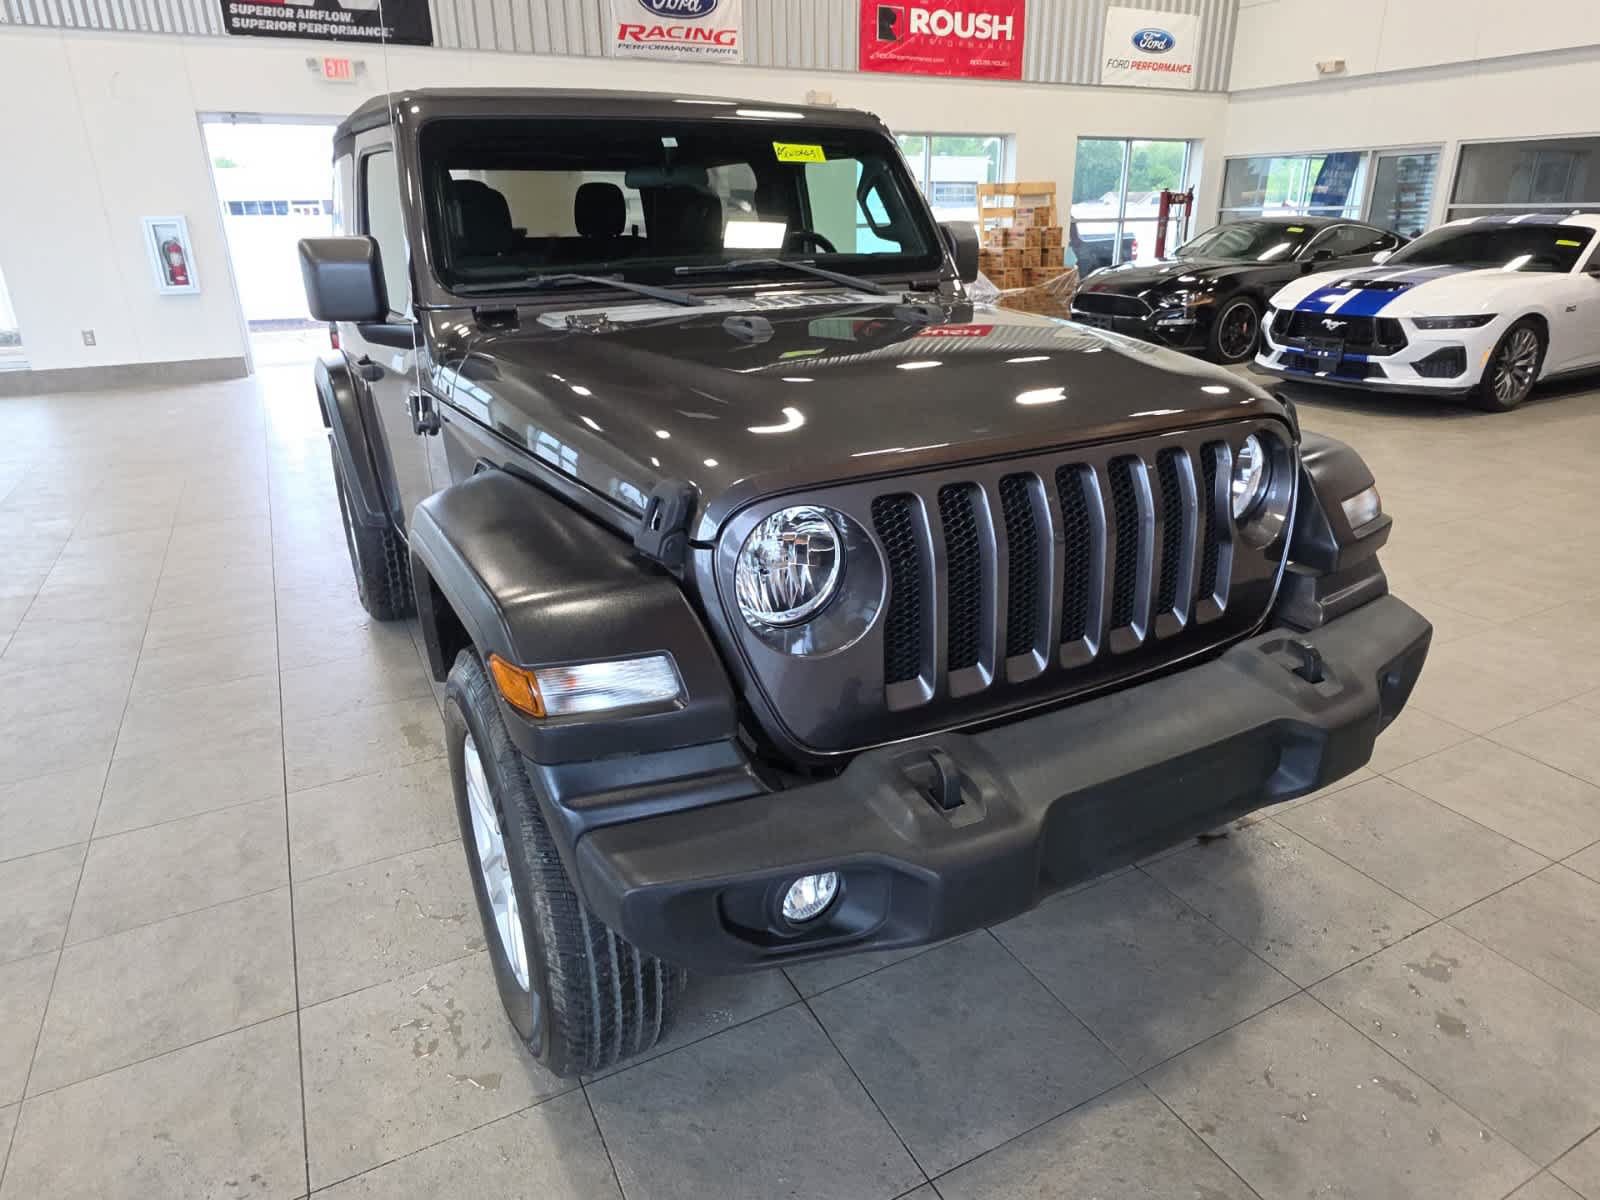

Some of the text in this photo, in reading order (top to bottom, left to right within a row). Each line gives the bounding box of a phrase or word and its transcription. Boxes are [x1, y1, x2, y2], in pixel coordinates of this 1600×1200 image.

[229, 3, 294, 18] SUPERIOR
[296, 8, 354, 23] AIRFLOW.
[231, 16, 297, 32] SUPERIOR
[910, 7, 1014, 41] ROUSH
[617, 23, 737, 46] RACING
[1139, 31, 1168, 50] Ford
[617, 43, 703, 53] PERFORMANCE
[324, 57, 350, 78] EXIT
[1106, 58, 1193, 74] FORD PERFORMANCE
